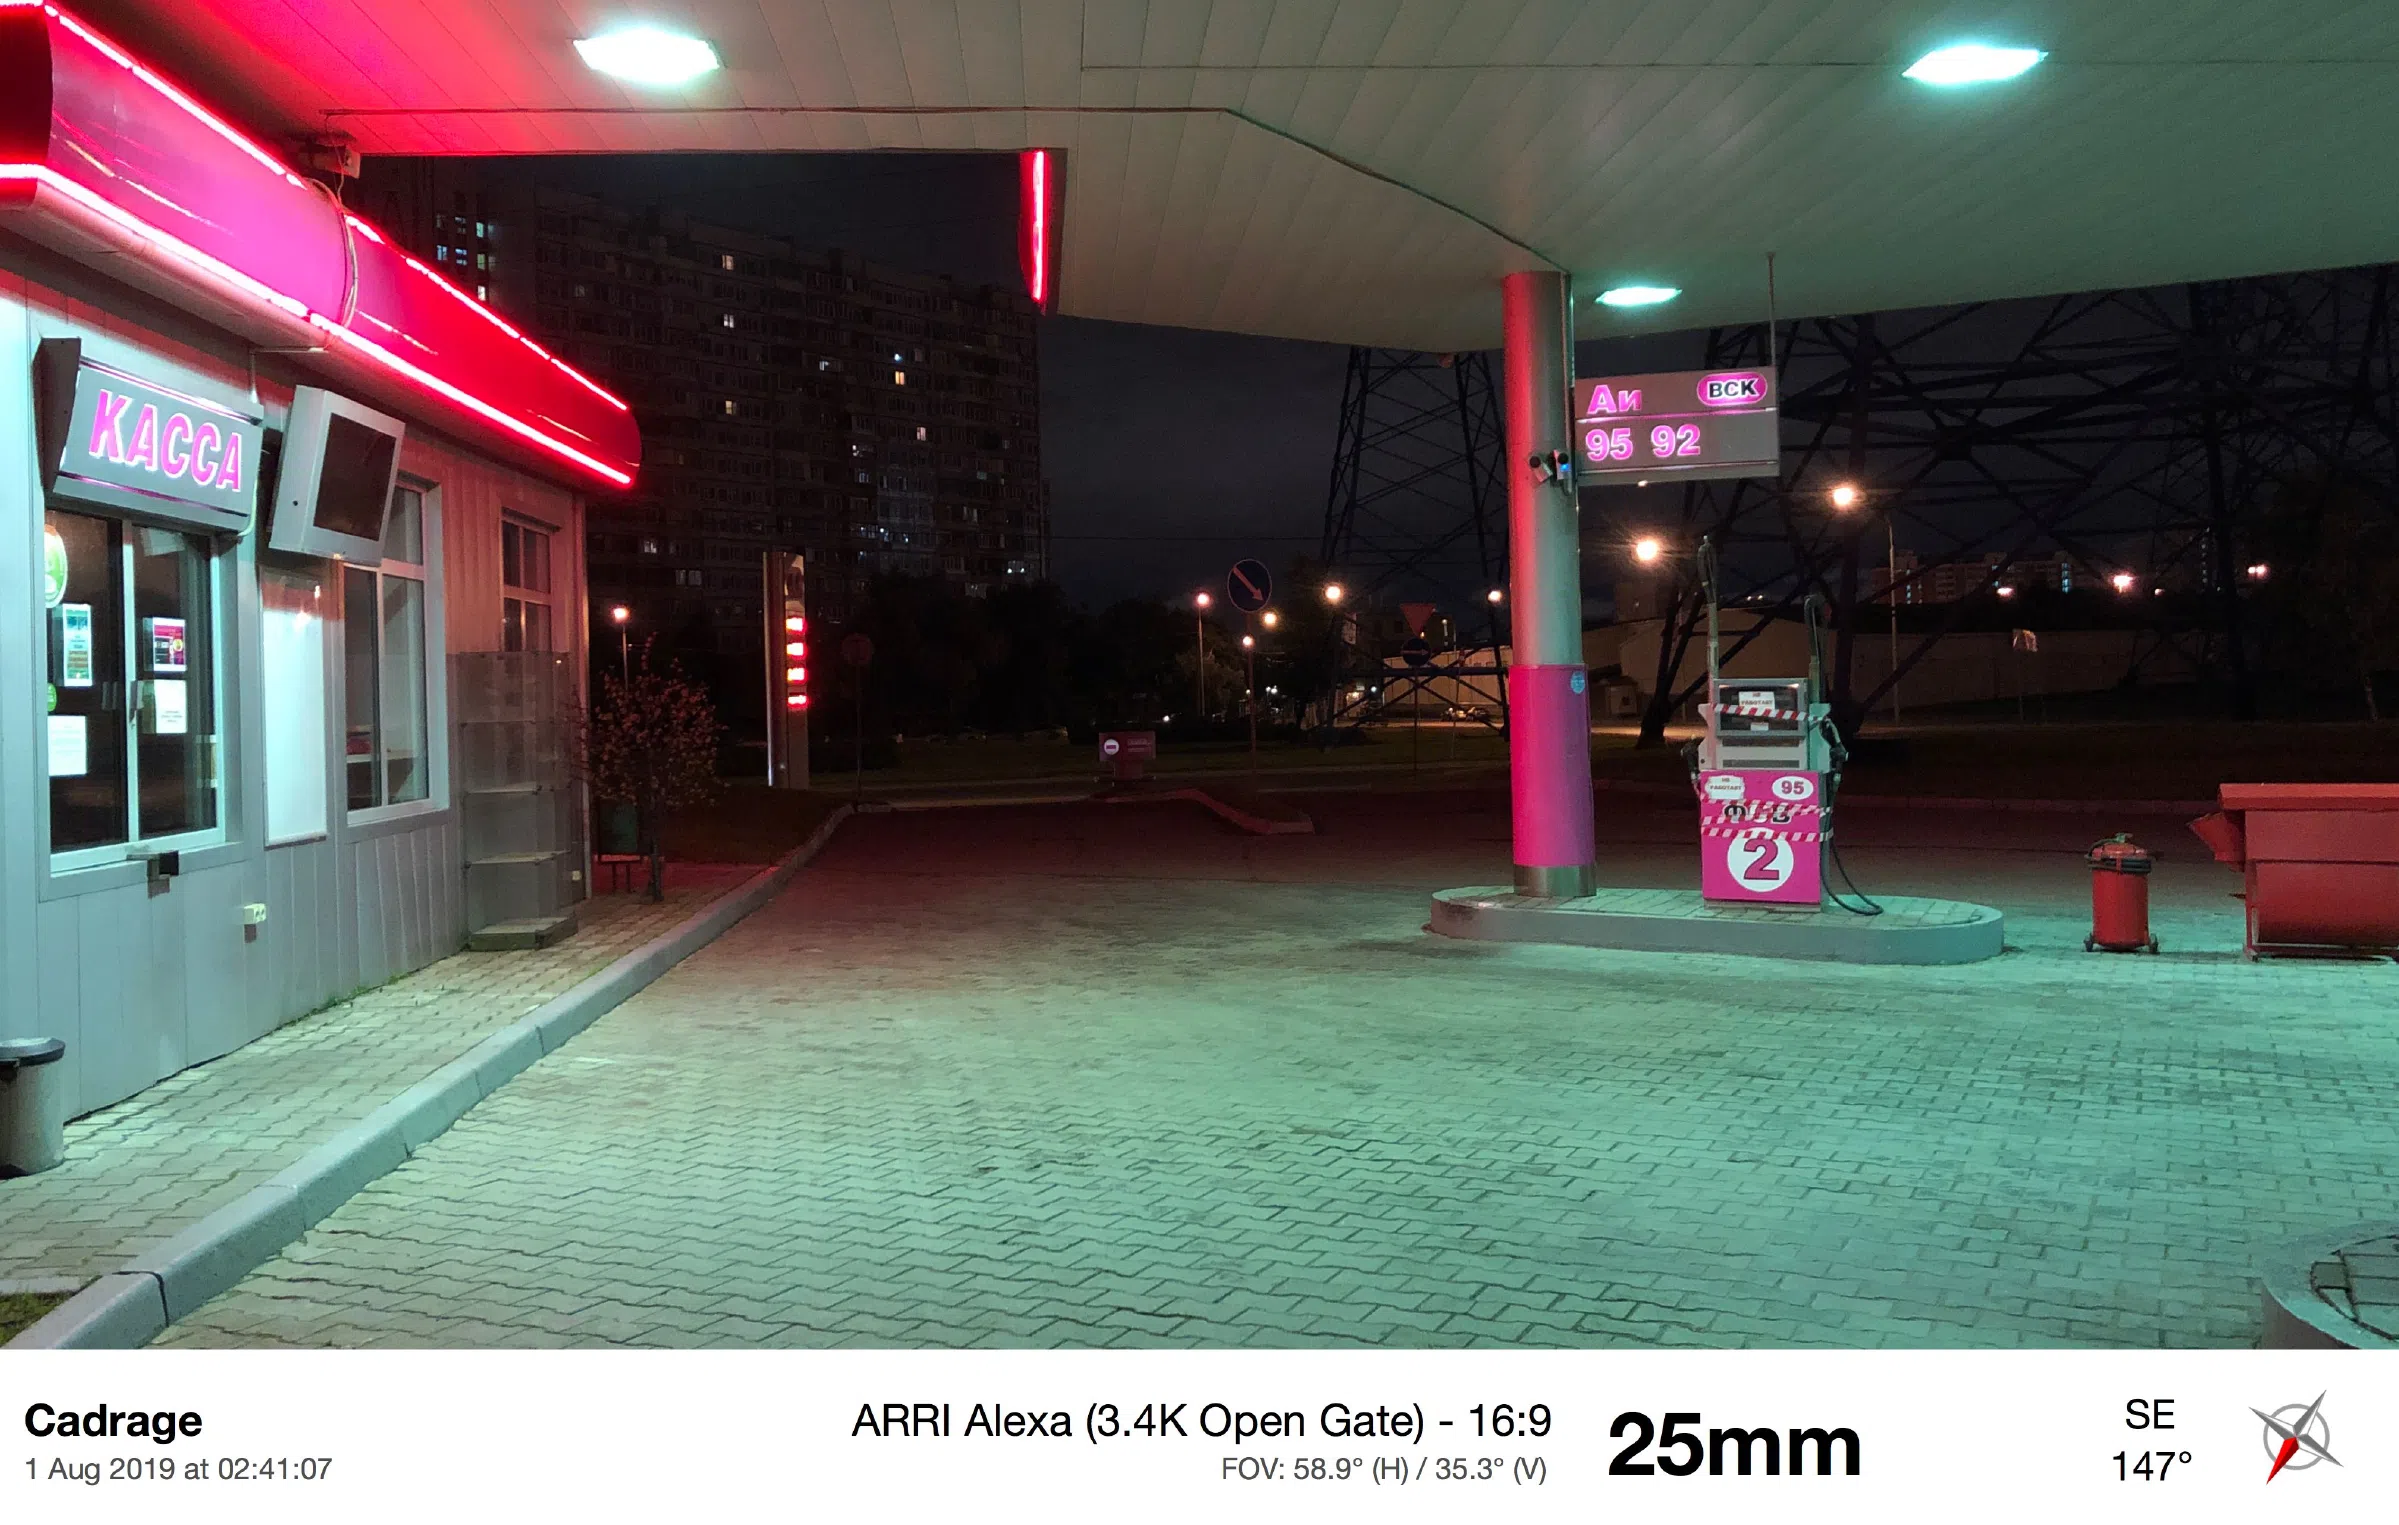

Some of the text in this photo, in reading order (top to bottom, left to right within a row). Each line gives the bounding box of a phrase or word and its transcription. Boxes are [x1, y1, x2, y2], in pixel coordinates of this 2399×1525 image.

[1708, 378, 1760, 400] ВСК
[88, 388, 242, 493] КАССА
[1585, 424, 1701, 462] 95 92
[1781, 780, 1805, 795] 95
[1743, 837, 1780, 881] 2
